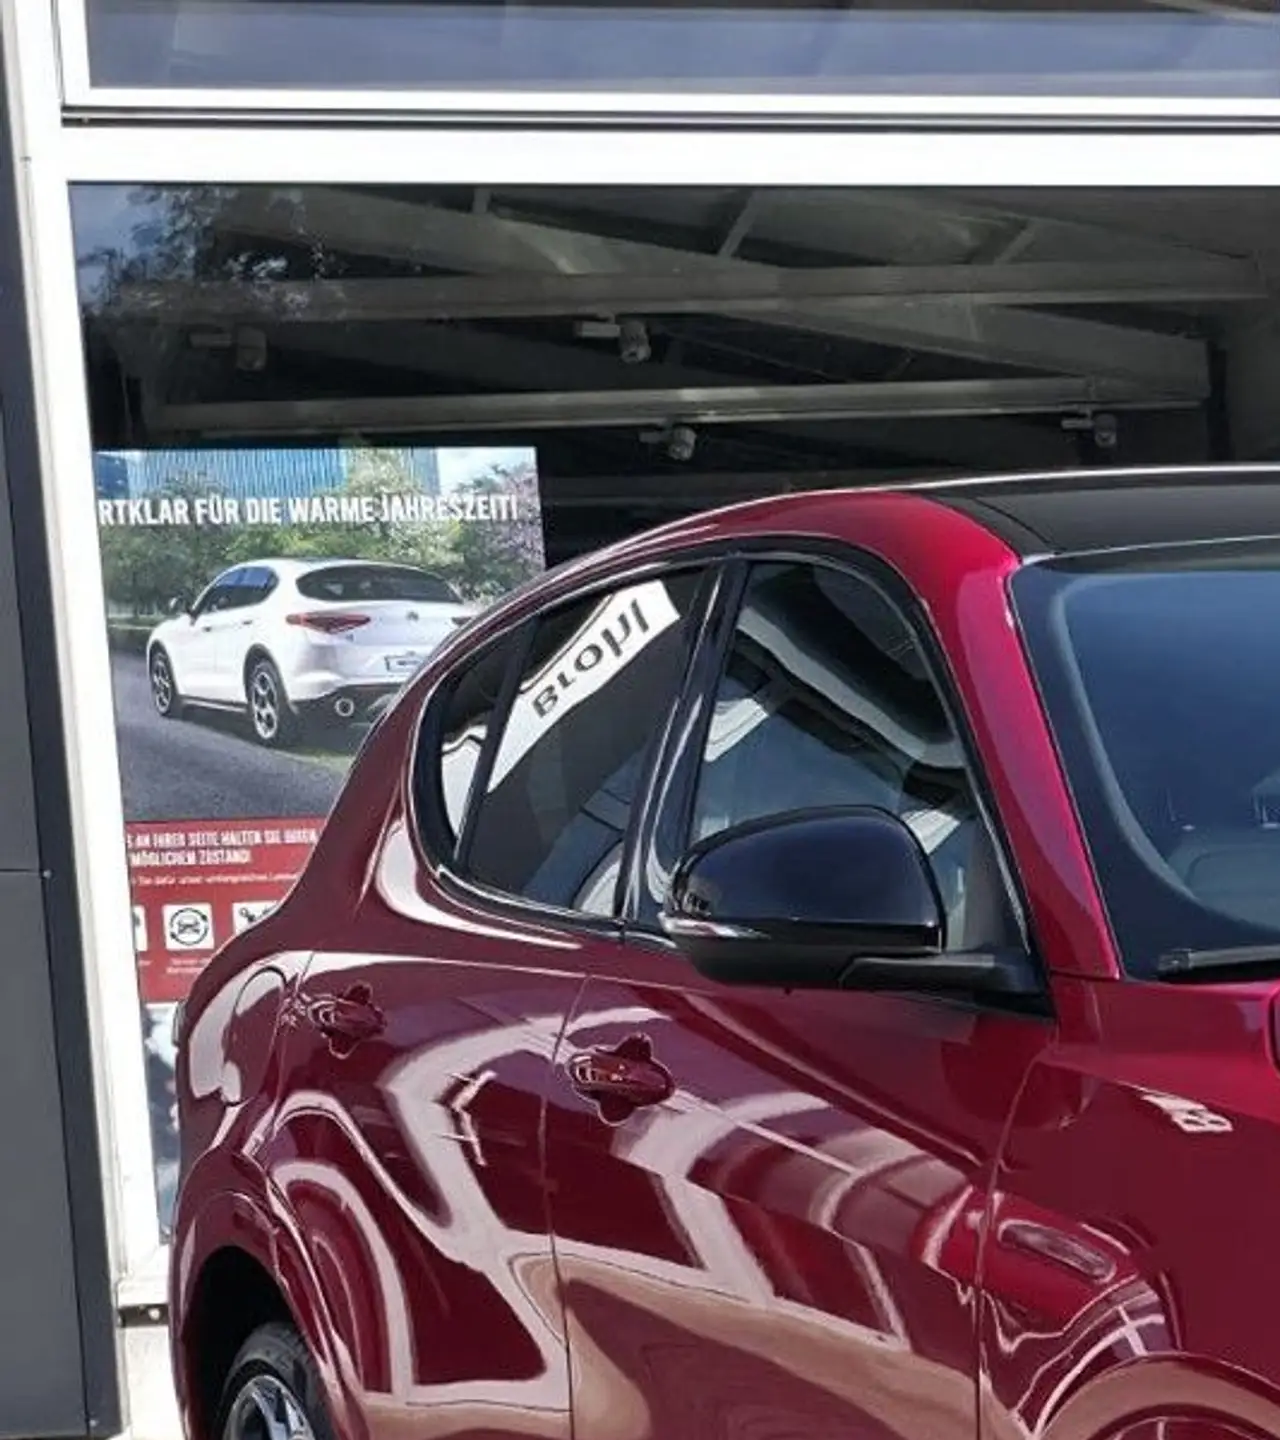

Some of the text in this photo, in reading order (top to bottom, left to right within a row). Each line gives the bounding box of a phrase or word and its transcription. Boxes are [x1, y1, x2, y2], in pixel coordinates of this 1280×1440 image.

[100, 492, 517, 525] RTKLAR FÜR DIE WARME JAHRESZEIT!
